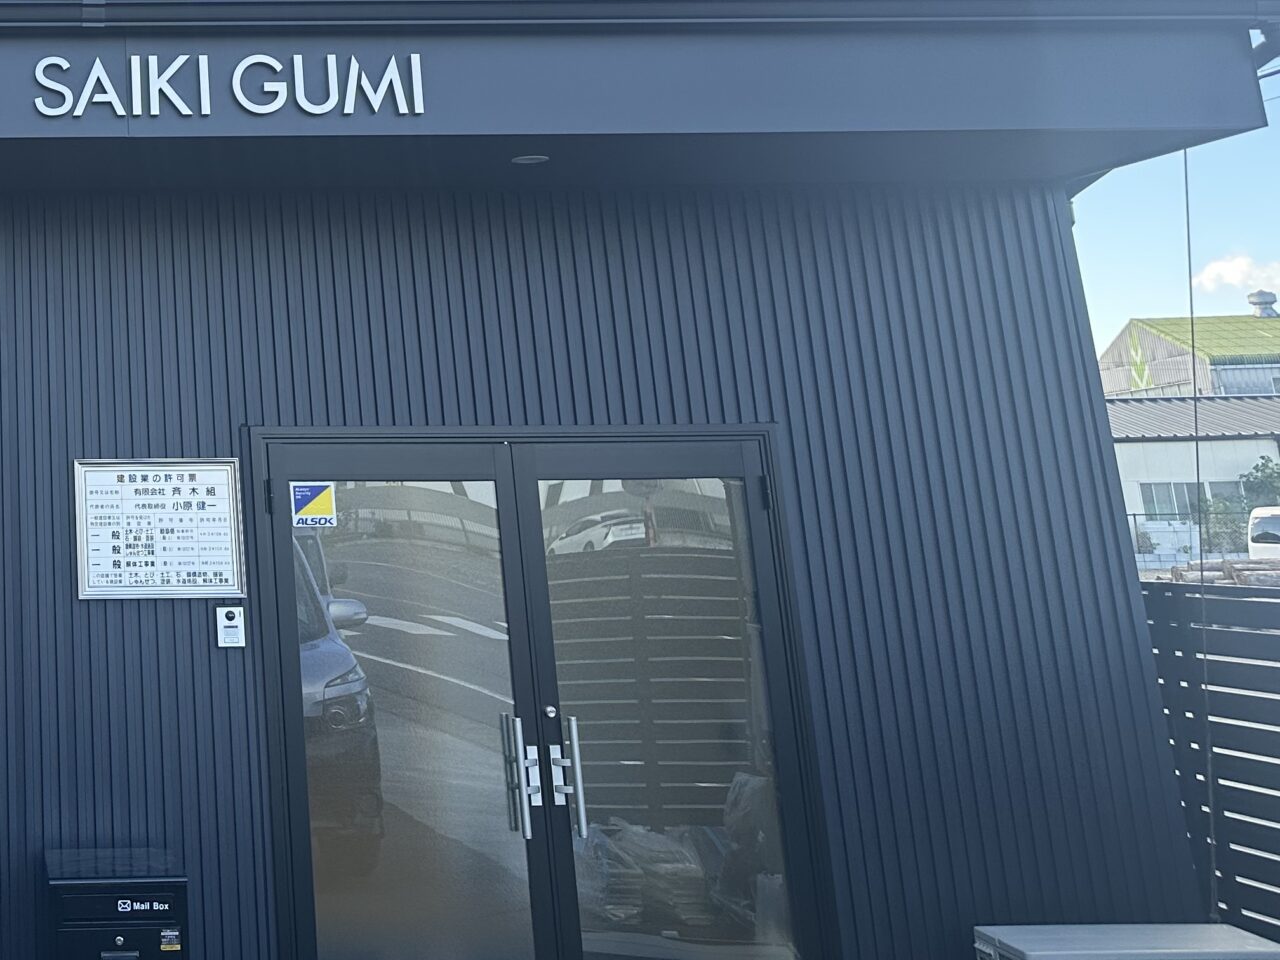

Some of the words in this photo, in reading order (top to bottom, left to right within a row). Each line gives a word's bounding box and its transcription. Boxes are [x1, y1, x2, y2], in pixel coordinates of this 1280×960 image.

[34, 54, 211, 116] SAIKI
[232, 53, 425, 115] GUMI
[116, 473, 197, 483] 建設業の許可票
[134, 487, 166, 496] 有限会社
[133, 902, 149, 910] Mail
[153, 902, 169, 910] Box
